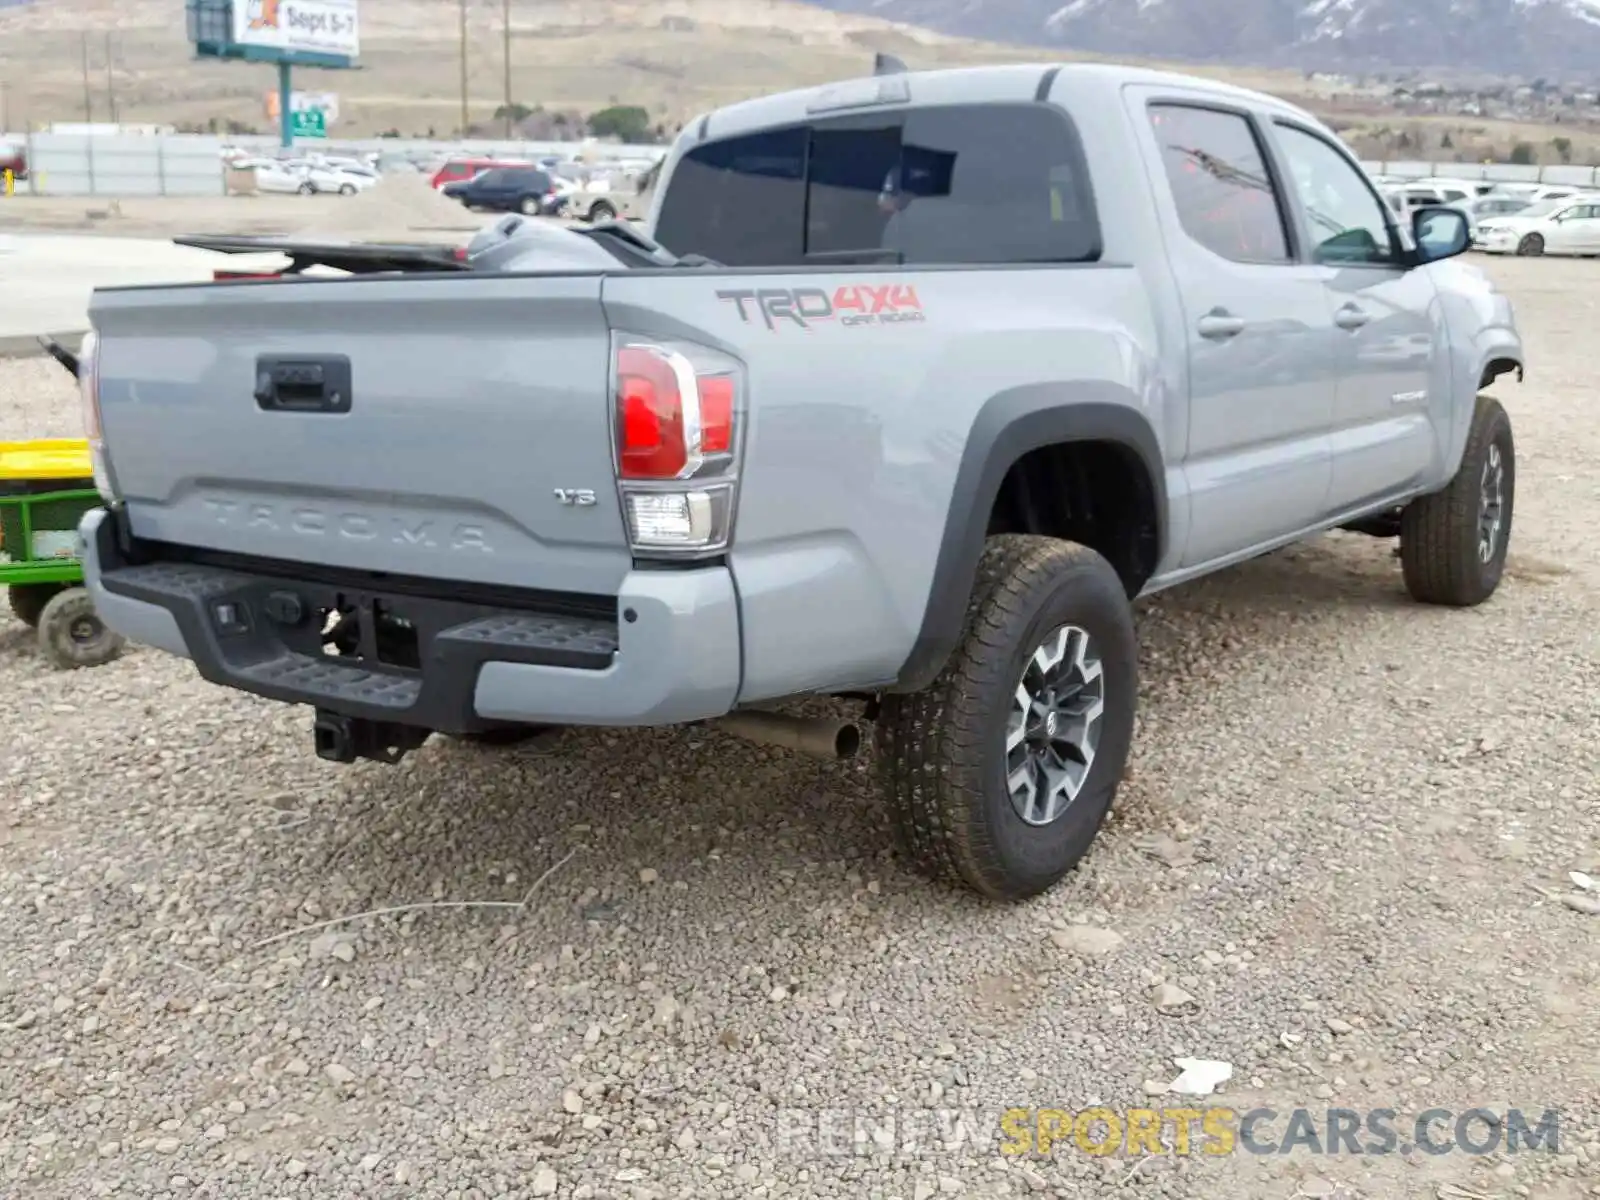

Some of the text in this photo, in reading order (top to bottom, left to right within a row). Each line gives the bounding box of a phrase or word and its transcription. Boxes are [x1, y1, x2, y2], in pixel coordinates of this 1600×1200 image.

[287, 5, 327, 35] Sept
[715, 288, 834, 331] TRD
[553, 488, 597, 506] V6
[204, 500, 494, 553] TACOMA
